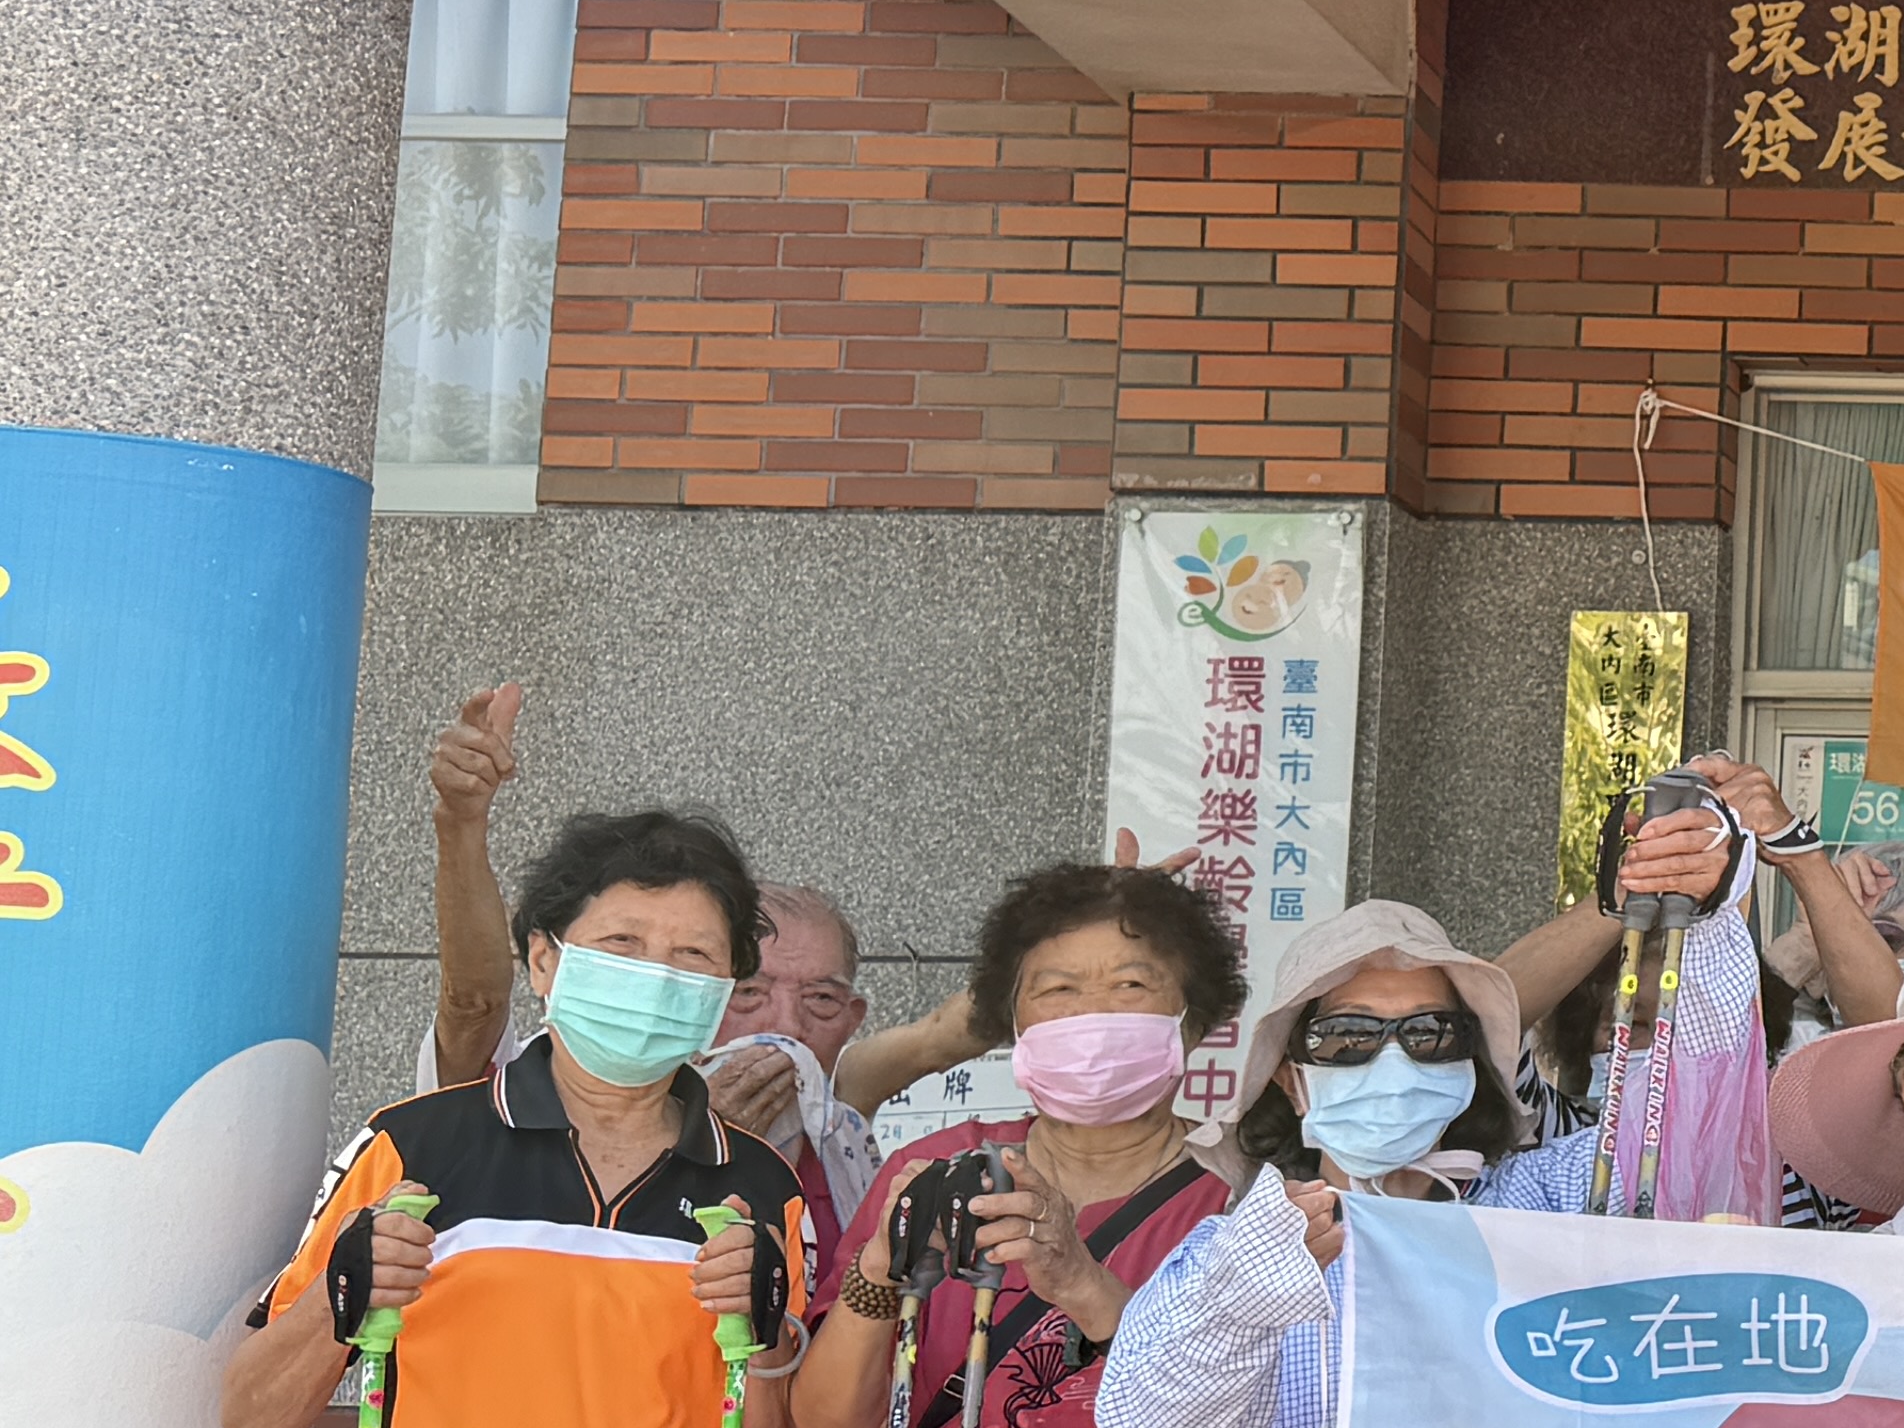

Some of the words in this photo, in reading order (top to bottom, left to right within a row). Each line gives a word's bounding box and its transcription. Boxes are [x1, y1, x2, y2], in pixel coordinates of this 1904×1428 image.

[1270, 658, 1319, 922] 臺南市大內區
[1852, 791, 1900, 826] 56
[1528, 1293, 1829, 1383] 吃在地
